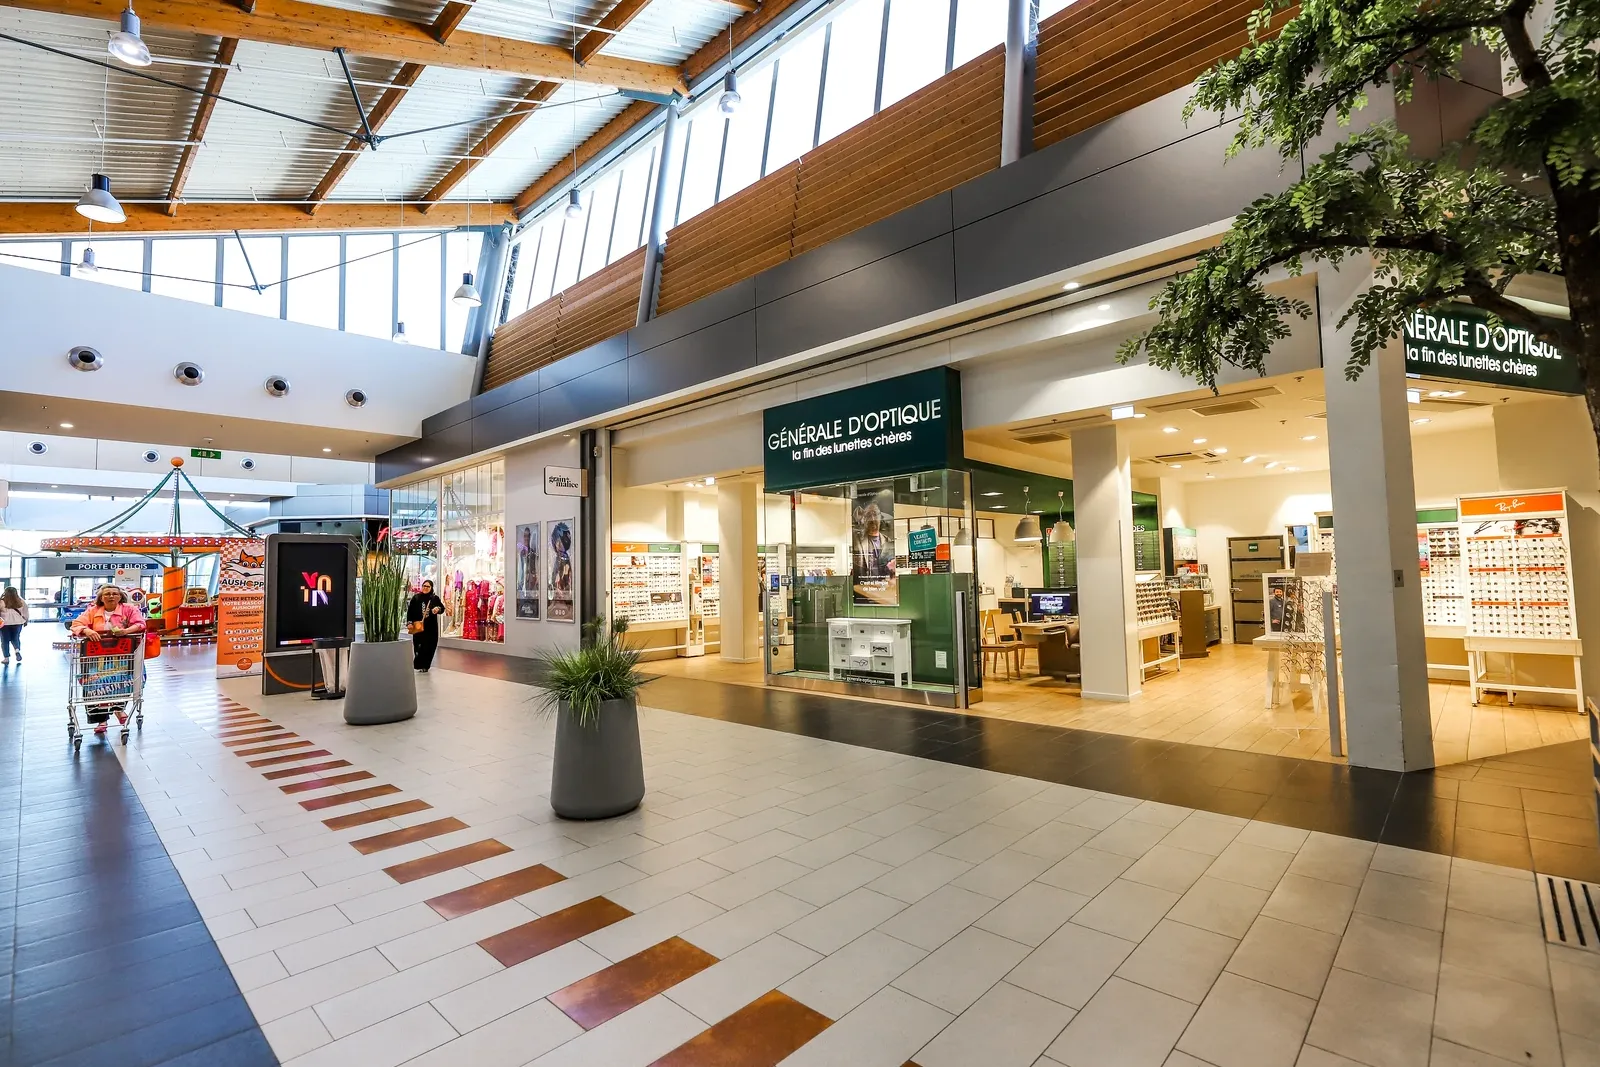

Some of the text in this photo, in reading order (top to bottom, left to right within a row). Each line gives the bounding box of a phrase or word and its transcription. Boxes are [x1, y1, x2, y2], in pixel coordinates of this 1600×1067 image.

[1406, 344, 1538, 377] la fin des lunettes chères
[767, 398, 941, 451] GÉNÉRALE D'OPTIQUE
[792, 430, 912, 461] la fin des lunettes chères
[556, 480, 579, 489] malice
[1494, 498, 1526, 512] Ray-Ban
